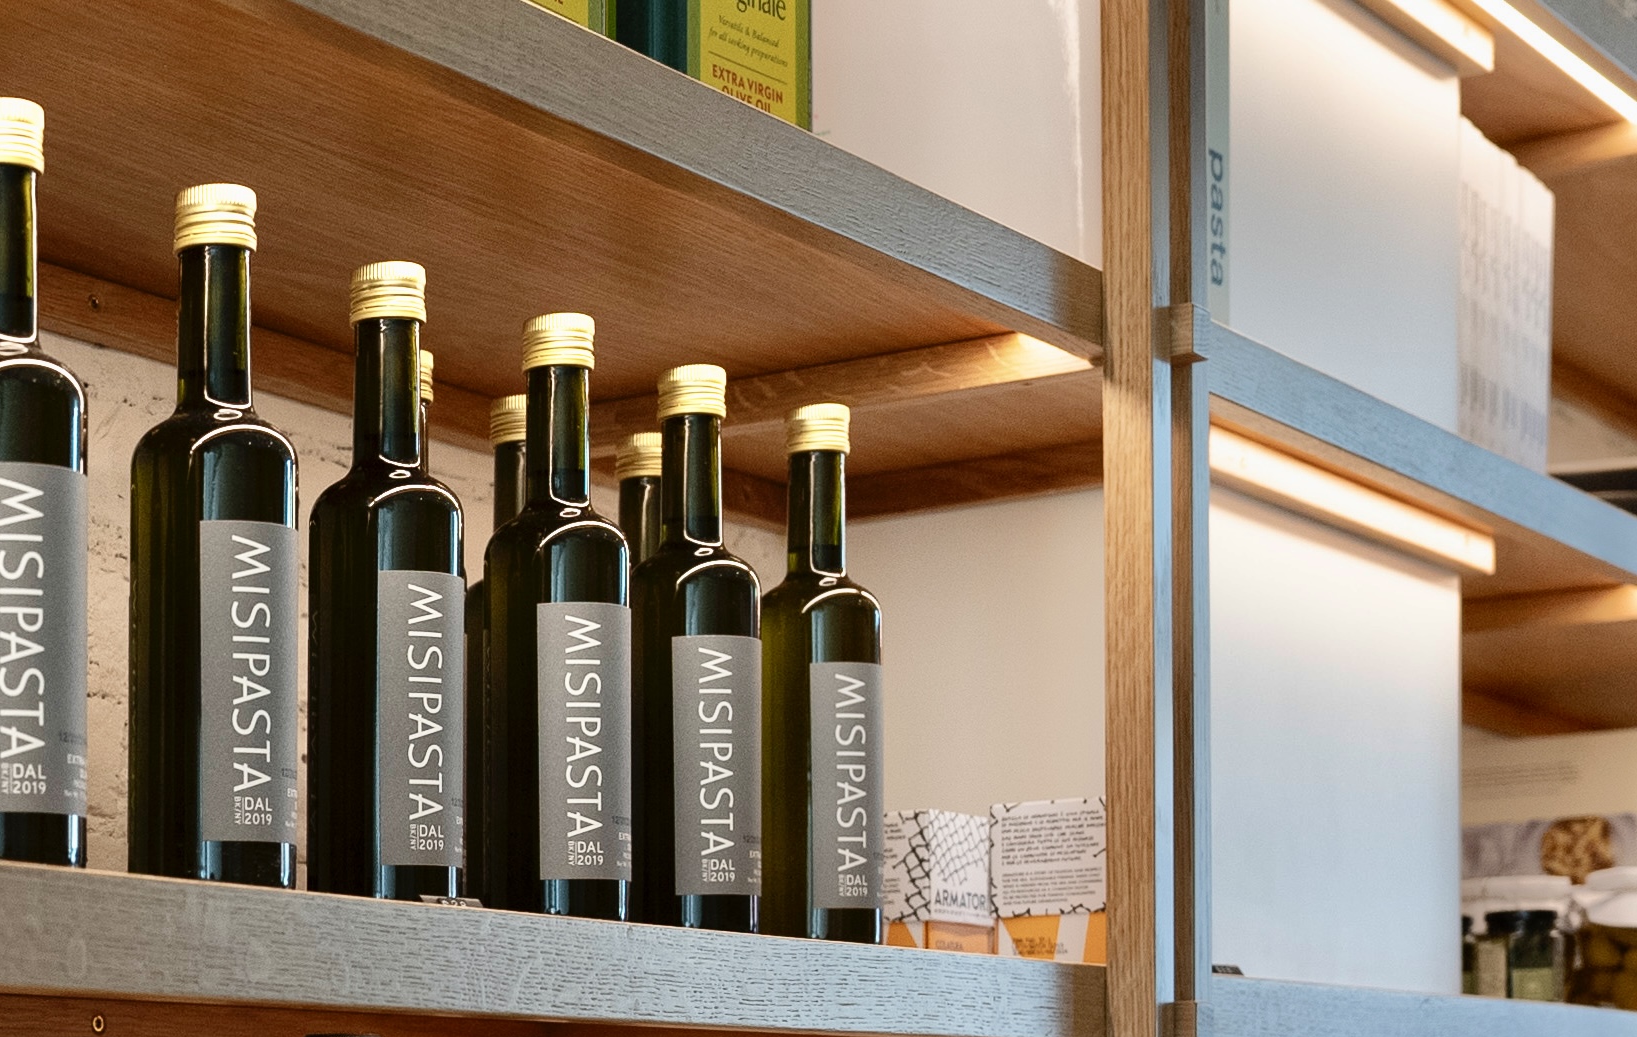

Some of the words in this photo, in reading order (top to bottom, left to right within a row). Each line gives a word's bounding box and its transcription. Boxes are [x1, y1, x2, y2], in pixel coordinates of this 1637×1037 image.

[712, 63, 746, 91] EXTRA
[746, 77, 784, 105] VIRGIN
[1208, 148, 1226, 286] pasta
[231, 534, 272, 792] MISIPASTA
[408, 583, 444, 820] MISIPASTA
[565, 614, 603, 838] MISIPASTA
[698, 647, 735, 856] MISIPASTA
[12, 763, 47, 780] DAL
[834, 673, 868, 872] MISIPASTA
[12, 780, 47, 795] 2019
[244, 796, 273, 812] DAL
[244, 812, 273, 826] 2019
[419, 824, 444, 838] DAL
[419, 838, 444, 851] 2019
[577, 841, 604, 854] DAL
[577, 854, 604, 866] 2019
[710, 858, 736, 871] DAL
[710, 871, 736, 883] 2019
[846, 874, 868, 886] DAL
[846, 886, 868, 897] 2019
[934, 889, 990, 911] ARMATOR
